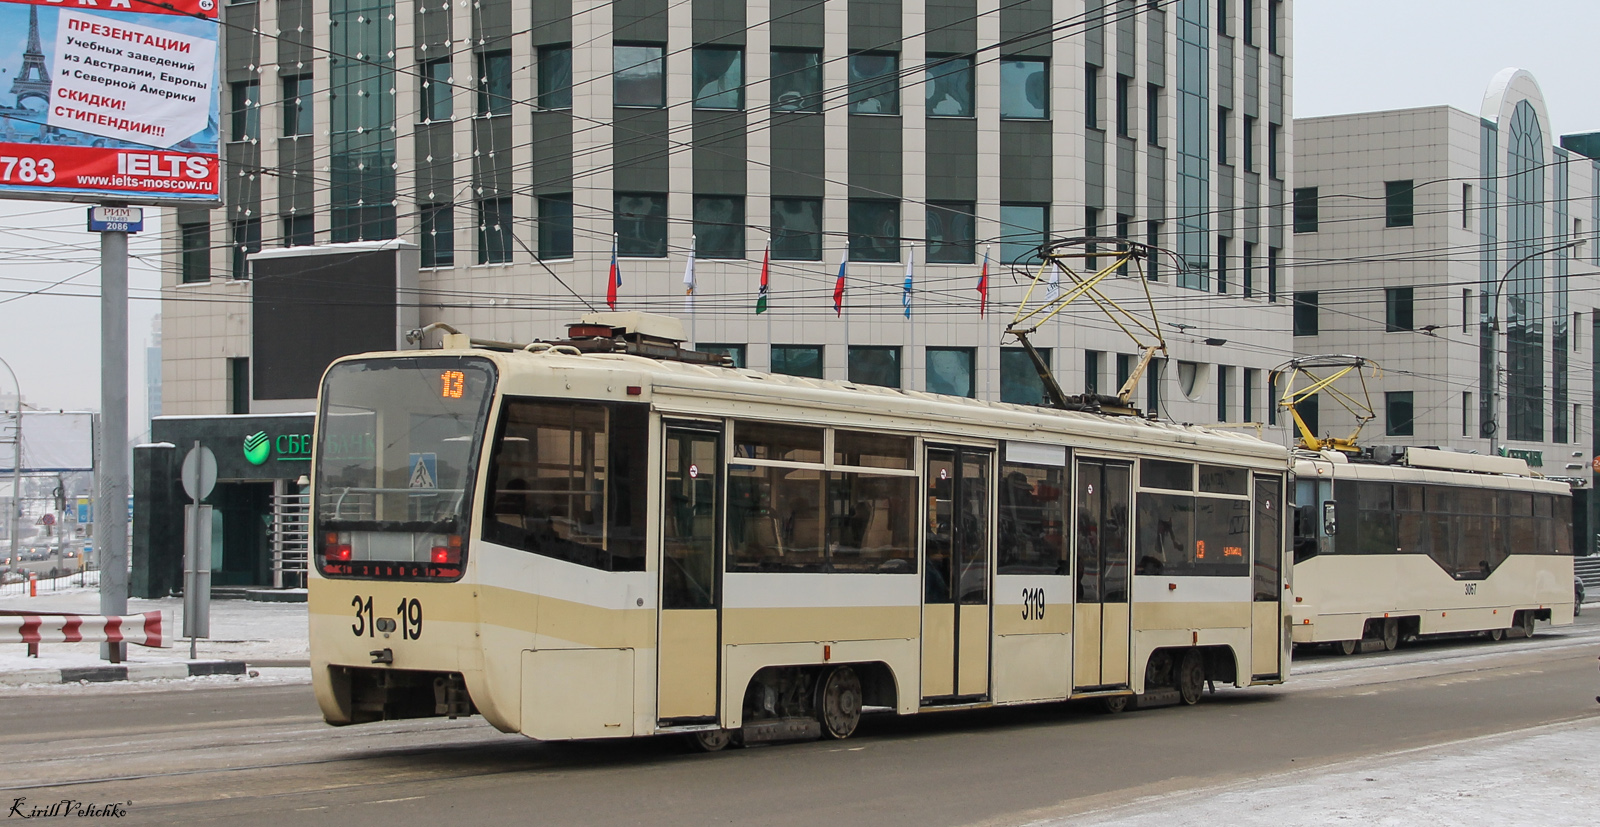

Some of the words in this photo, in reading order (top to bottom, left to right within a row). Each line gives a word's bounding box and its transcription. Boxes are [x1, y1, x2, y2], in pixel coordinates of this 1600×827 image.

[201, 0, 212, 8] 6+
[68, 18, 191, 54] ПРЕЗЕНТАЦИИ
[66, 36, 123, 57] Учебных
[127, 50, 196, 72] заведений
[64, 53, 80, 63] из
[84, 56, 156, 80] Австралии,
[159, 71, 208, 90] Европы
[57, 87, 126, 111] СКИДКИ!
[62, 68, 70, 76] и
[74, 69, 136, 91] Северной
[139, 83, 197, 103] Америки
[54, 106, 166, 137] СТИПЕНДИИ!!!
[0, 157, 56, 183] 783
[77, 175, 212, 190] www.ielts-moscow.ru
[103, 208, 131, 216] РИМ
[106, 222, 128, 230] 2086
[441, 370, 464, 398] 13
[275, 434, 376, 454] СБЕБАНК
[1465, 583, 1477, 595] 3067
[1021, 587, 1045, 620] 3119
[351, 595, 375, 638] 31
[397, 597, 423, 641] 19
